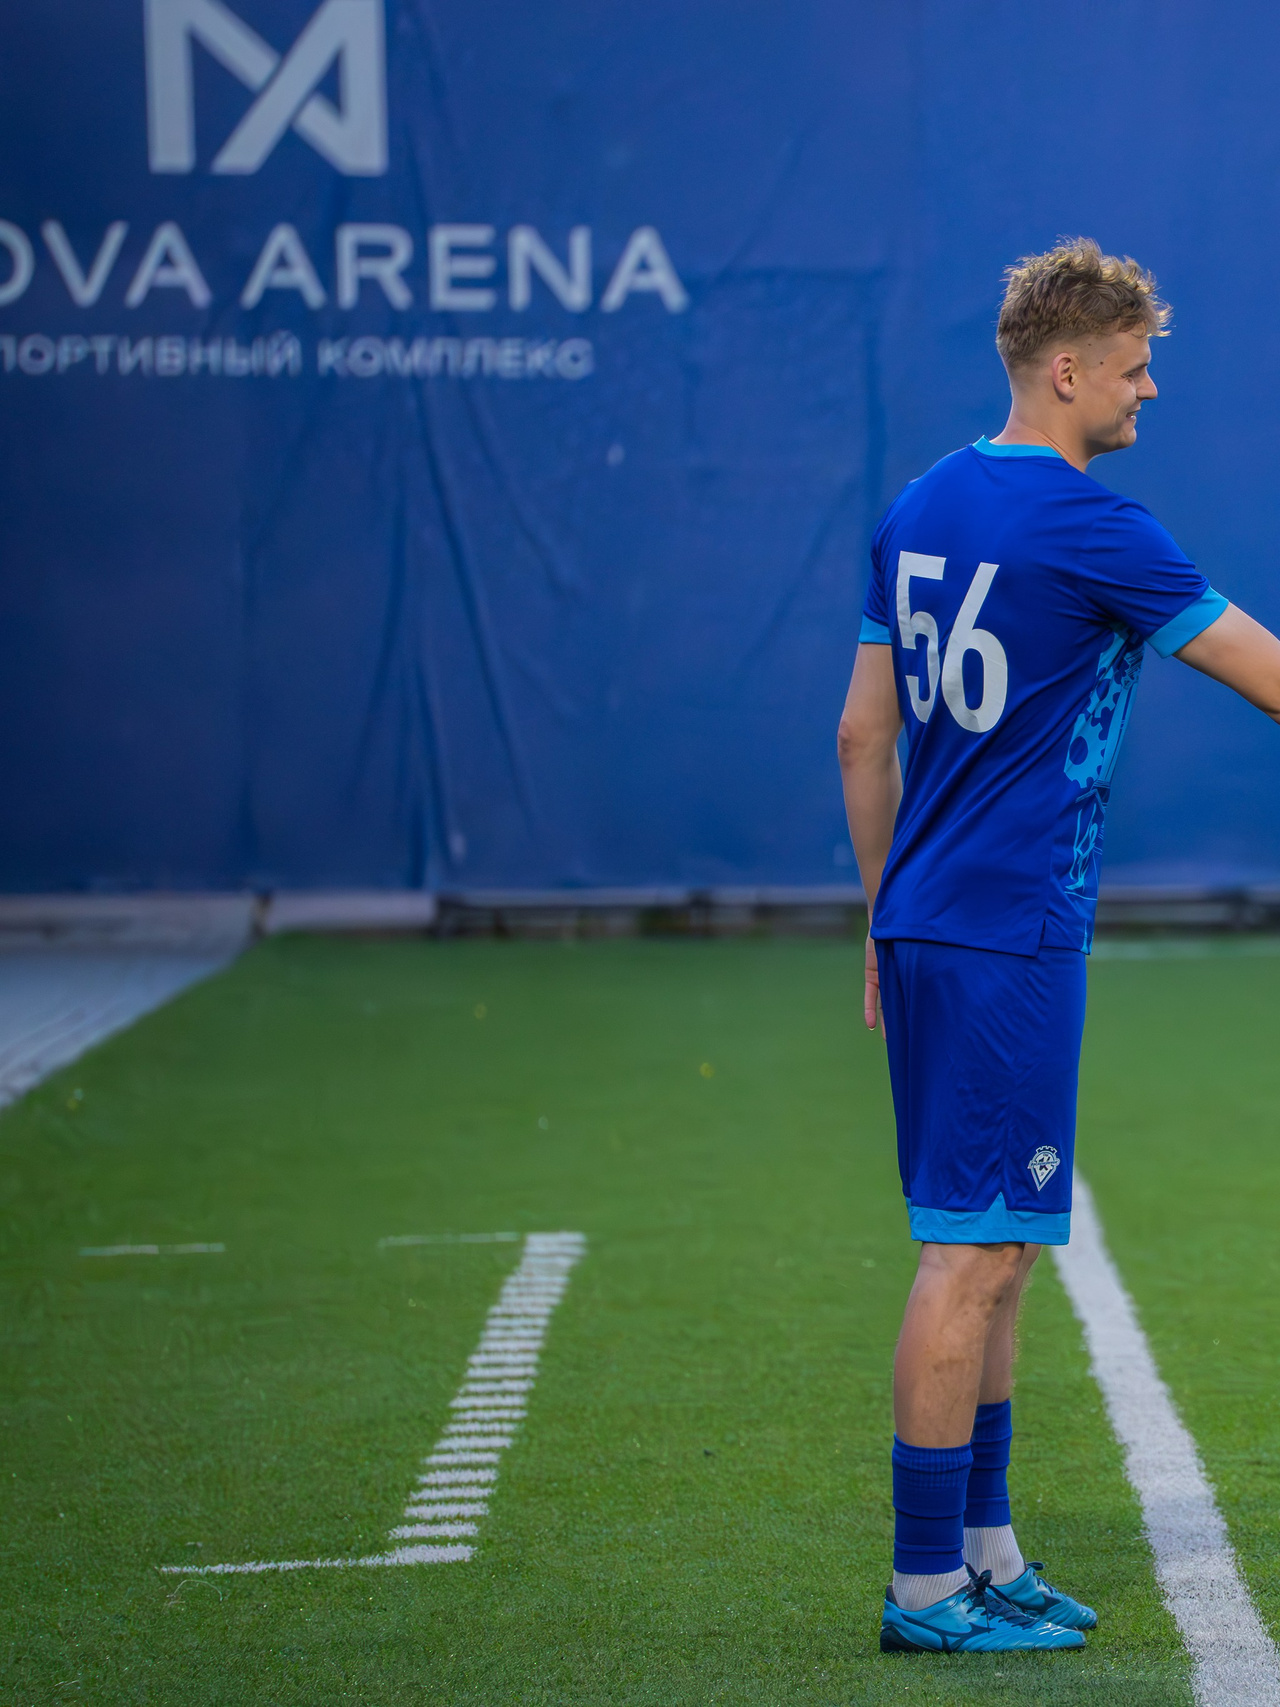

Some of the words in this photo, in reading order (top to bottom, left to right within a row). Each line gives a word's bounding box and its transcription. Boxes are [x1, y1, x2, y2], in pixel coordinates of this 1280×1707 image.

[242, 223, 687, 312] ARENA
[318, 337, 594, 380] КОМПЛЕКС
[896, 550, 1008, 733] 56
